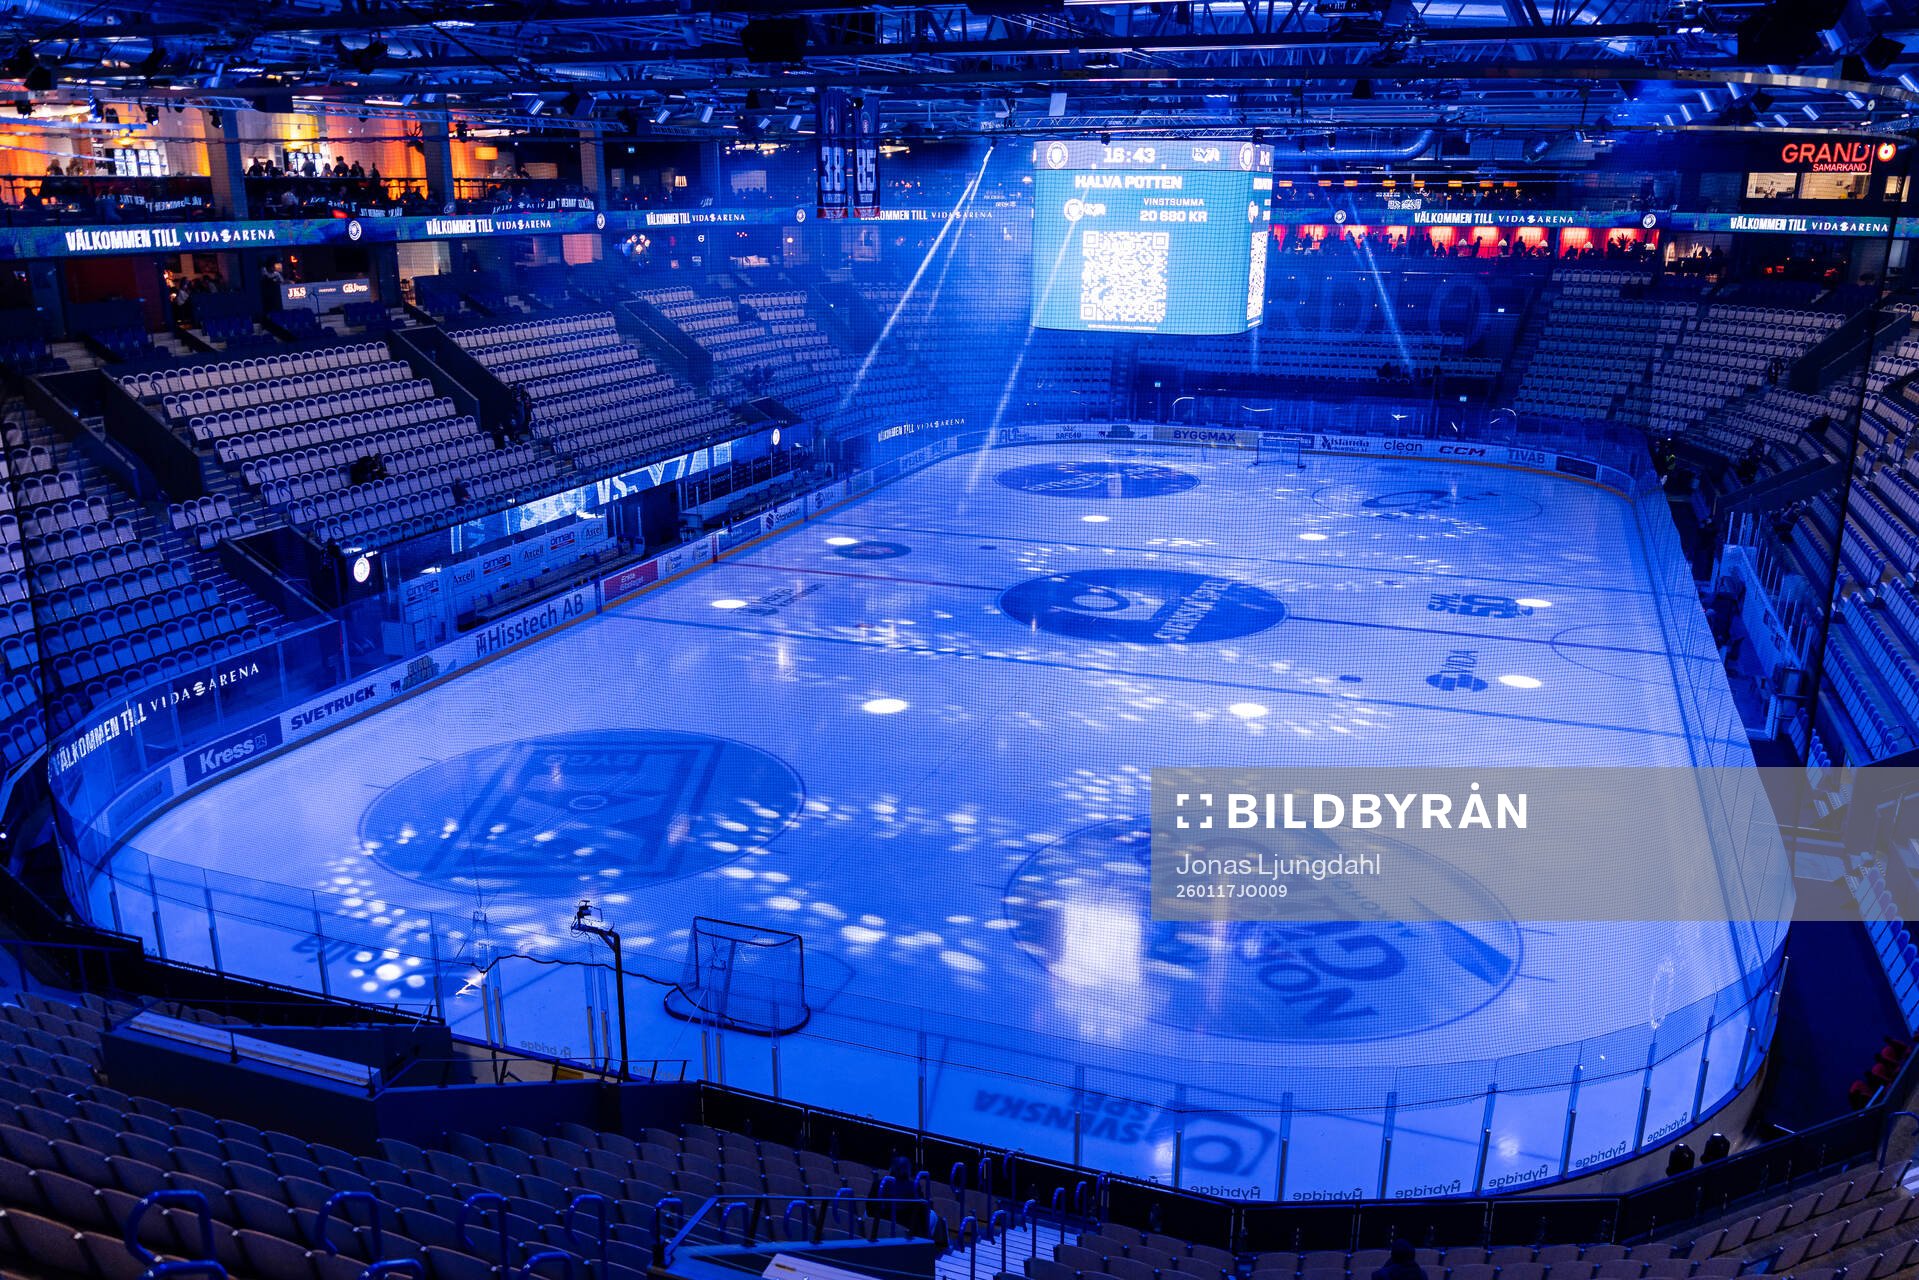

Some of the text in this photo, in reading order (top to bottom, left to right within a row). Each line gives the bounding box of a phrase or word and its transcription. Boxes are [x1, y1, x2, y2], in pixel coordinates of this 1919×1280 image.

[1782, 142, 1870, 164] GRAND
[820, 146, 846, 192] 38
[856, 148, 877, 192] 85
[1812, 163, 1867, 172] SAMARKAND
[1074, 175, 1183, 189] HALVA POTTEN
[1143, 198, 1205, 206] VINSTSUMMA
[646, 212, 745, 226] VÄLKOMMEN TILL VIDA ARENA
[911, 209, 928, 220] TILL
[1188, 211, 1208, 222] KR
[1414, 211, 1574, 224] VÄLKOMMEN TILL VIDA ARENA
[426, 218, 551, 235] VÄLKOMMEN TILL VIDA ARENA
[1730, 216, 1889, 232] VÄLKOMMEN TILL VIDA ARENA
[65, 228, 276, 251] VÄLKOMMEN TILL VIDA ARENA
[903, 422, 915, 435] TILL
[940, 417, 966, 427] ARENA
[1173, 430, 1237, 442] BYGGMAX
[1383, 439, 1423, 453] clean
[1438, 445, 1487, 458] CCM
[1507, 448, 1546, 465] TIVAB
[488, 593, 584, 648] Hisstech AB
[120, 702, 147, 733] TILL
[150, 688, 191, 712] VIDA
[208, 663, 260, 691] ARENA
[290, 684, 377, 731] SVETRUCK
[200, 737, 255, 774] Kress
[972, 1089, 1146, 1146] SVENSKA
